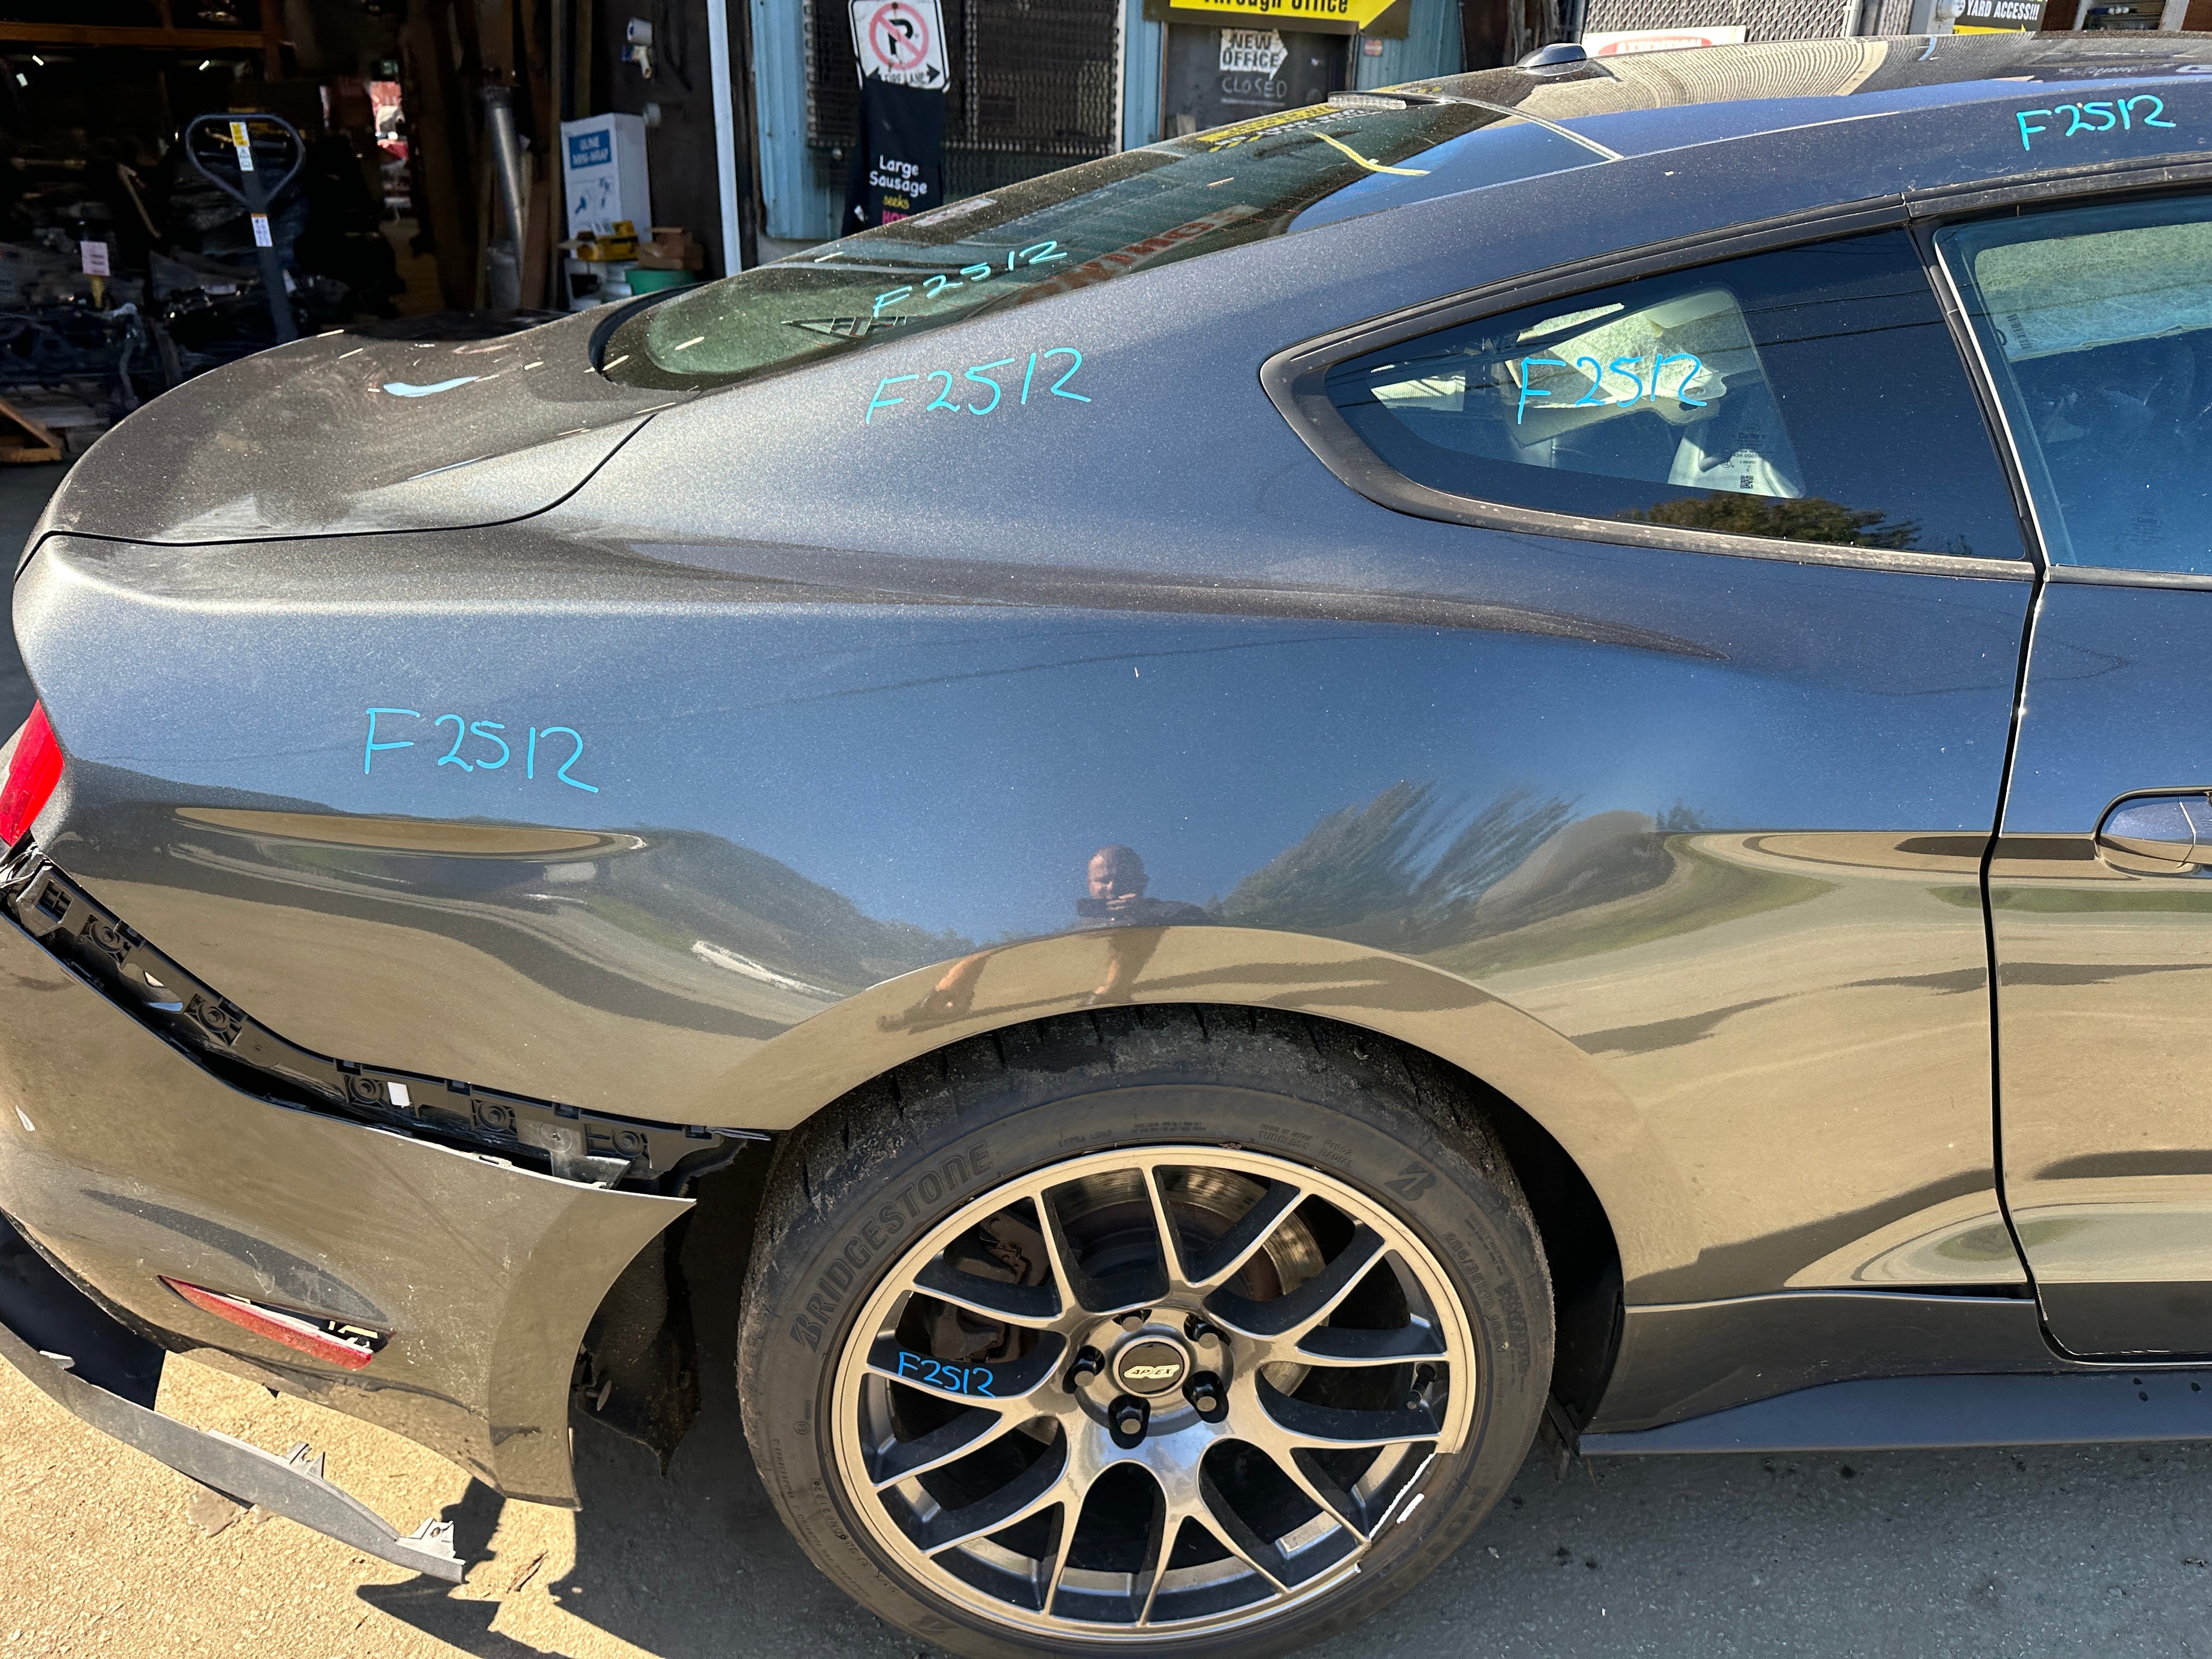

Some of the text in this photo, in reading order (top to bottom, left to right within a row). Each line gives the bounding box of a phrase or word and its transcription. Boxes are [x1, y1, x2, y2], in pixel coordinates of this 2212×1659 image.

[1967, 0, 2040, 21] YARD ACCESS!!!
[1232, 33, 1271, 50] NEW
[1616, 37, 1702, 54] ATTENTION
[1222, 48, 1280, 68] OFFICE
[1221, 76, 1287, 100] CLOSED
[2016, 94, 2176, 151] F2512
[879, 154, 919, 179] Large
[869, 170, 927, 198] Sausage
[872, 240, 1067, 317] F2512
[865, 347, 1092, 425] F2512
[1517, 353, 1707, 425] F2512
[363, 707, 600, 794] F2512
[1258, 1130, 1310, 1150] TUBELESS
[790, 1140, 993, 1354] BRIDGESTONE
[897, 1352, 996, 1398] F2512
